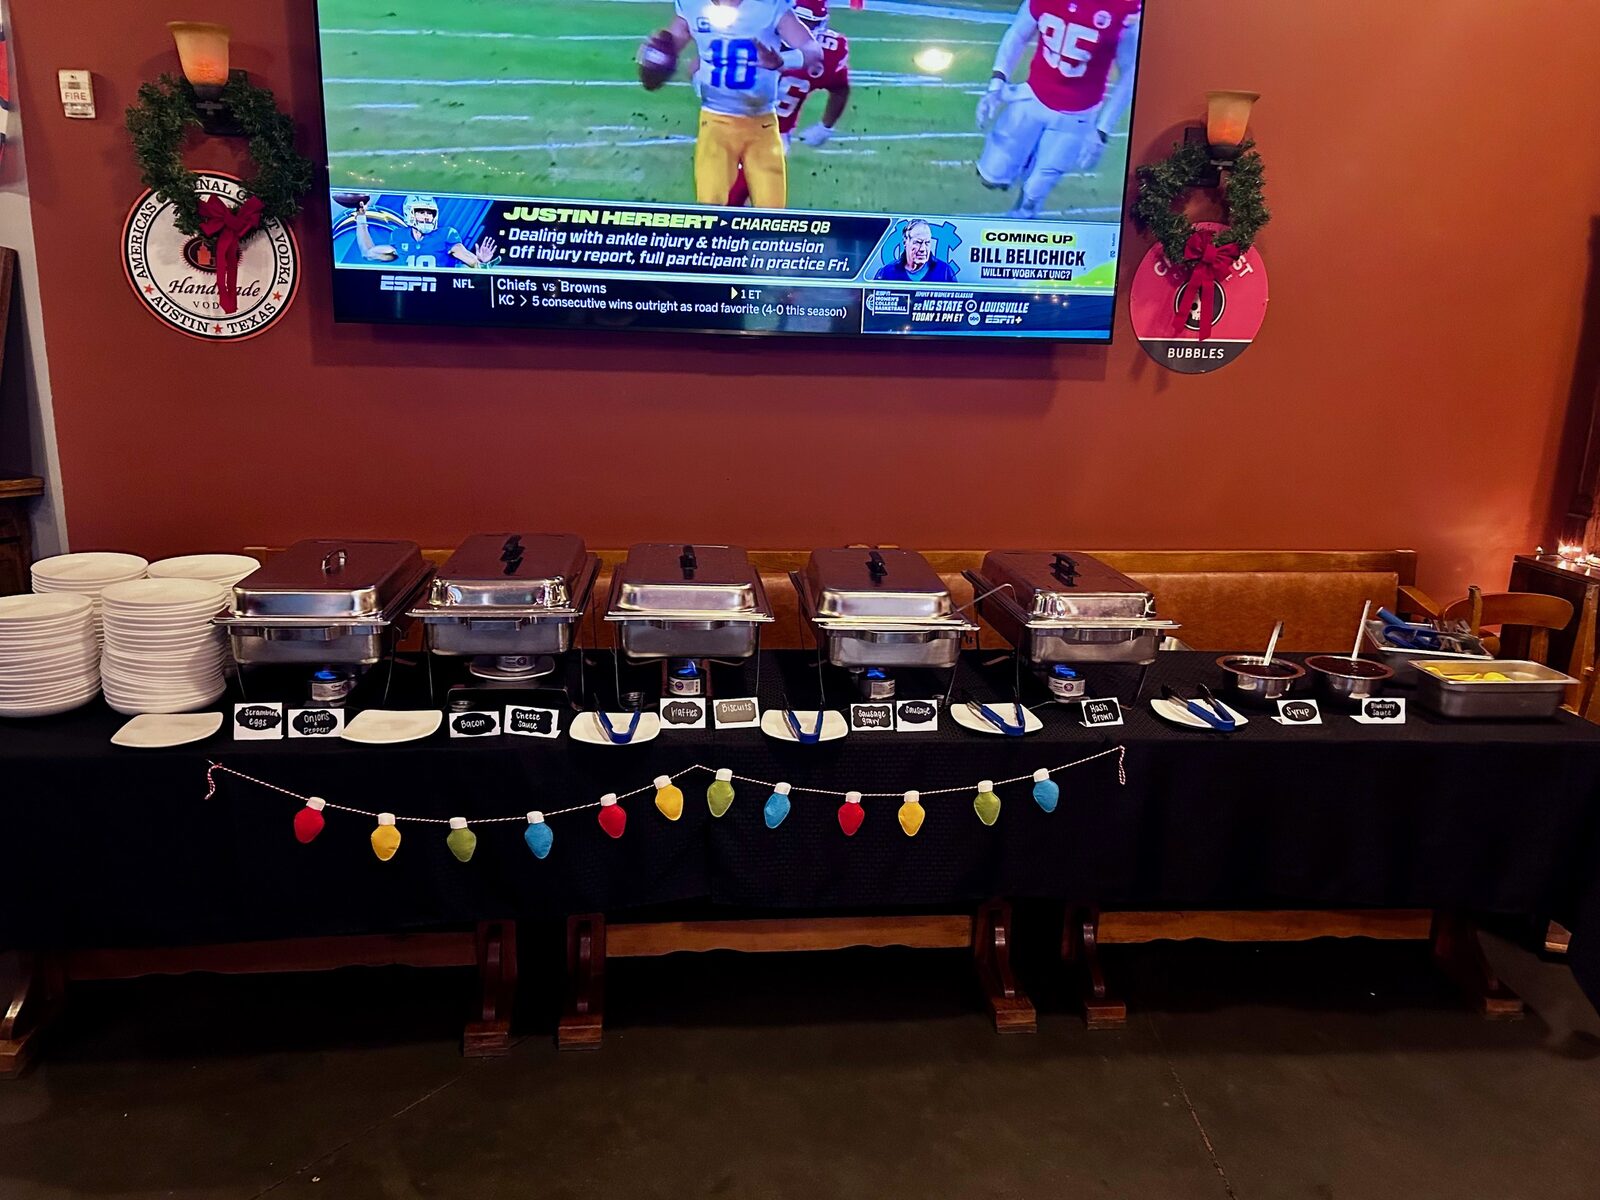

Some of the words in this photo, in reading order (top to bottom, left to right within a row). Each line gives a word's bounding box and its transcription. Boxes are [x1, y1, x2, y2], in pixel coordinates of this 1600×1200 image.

[1038, 12, 1099, 78] 95
[710, 38, 758, 90] 10
[64, 91, 88, 101] FIRE
[503, 206, 599, 224] JUSTIN
[601, 211, 718, 229] HERBERT
[731, 217, 808, 233] CHARGERS
[810, 220, 831, 235] QB
[130, 201, 157, 281] AMERICA'S
[508, 227, 566, 244] Dealing
[569, 228, 603, 245] with
[606, 233, 648, 247] ankle
[650, 234, 693, 250] injury
[696, 236, 708, 249] &
[711, 236, 749, 252] thigh
[752, 239, 824, 254] contusion
[985, 232, 1049, 244] COMING
[1052, 234, 1074, 244] UP
[275, 233, 291, 286] VODKA
[508, 245, 535, 260] Off
[537, 246, 580, 263] injury
[583, 249, 636, 266] report,
[640, 251, 664, 265] full
[666, 252, 748, 269] participant
[751, 255, 764, 269] in
[766, 257, 825, 272] practice
[828, 258, 850, 272] Fri.
[969, 247, 1002, 264] BILL
[1006, 248, 1086, 267] BELICHICK
[982, 267, 1003, 278] WILL
[1003, 268, 1011, 278] IT
[1036, 269, 1049, 279] AT
[1049, 269, 1071, 280] UNC?
[168, 276, 261, 298] Handade
[380, 275, 437, 292] ESPN
[452, 278, 475, 289] NFL
[497, 279, 537, 291] Chiefs
[542, 283, 556, 292] vs
[561, 280, 607, 294] Browns
[741, 289, 747, 299] 1
[748, 289, 762, 300] ET
[498, 295, 515, 306] KC
[532, 296, 540, 307] 5
[542, 297, 606, 310] consecutive
[608, 300, 633, 311] wins
[635, 301, 678, 314] outright
[680, 304, 693, 313] as
[695, 302, 719, 313] road
[721, 302, 760, 315] favorite
[761, 304, 784, 317] (4-0
[786, 304, 805, 316] this
[807, 306, 847, 319] season)
[922, 299, 936, 311] NC
[936, 300, 963, 312] STATE
[979, 301, 1030, 313] LOUISVILLE
[151, 295, 211, 333] AUSTIN
[227, 302, 277, 334] TEXAS
[912, 312, 935, 322] TODAY
[941, 313, 953, 322] PM
[953, 313, 964, 322] ET
[1167, 347, 1225, 359] BUBBLES
[722, 702, 753, 713] Biscuits
[1090, 703, 1109, 713] Hash
[1286, 706, 1310, 718] Syrup
[303, 712, 330, 723] Onions
[515, 711, 541, 721] Cheese
[1091, 712, 1114, 723] Brown
[460, 719, 486, 729] Bacon
